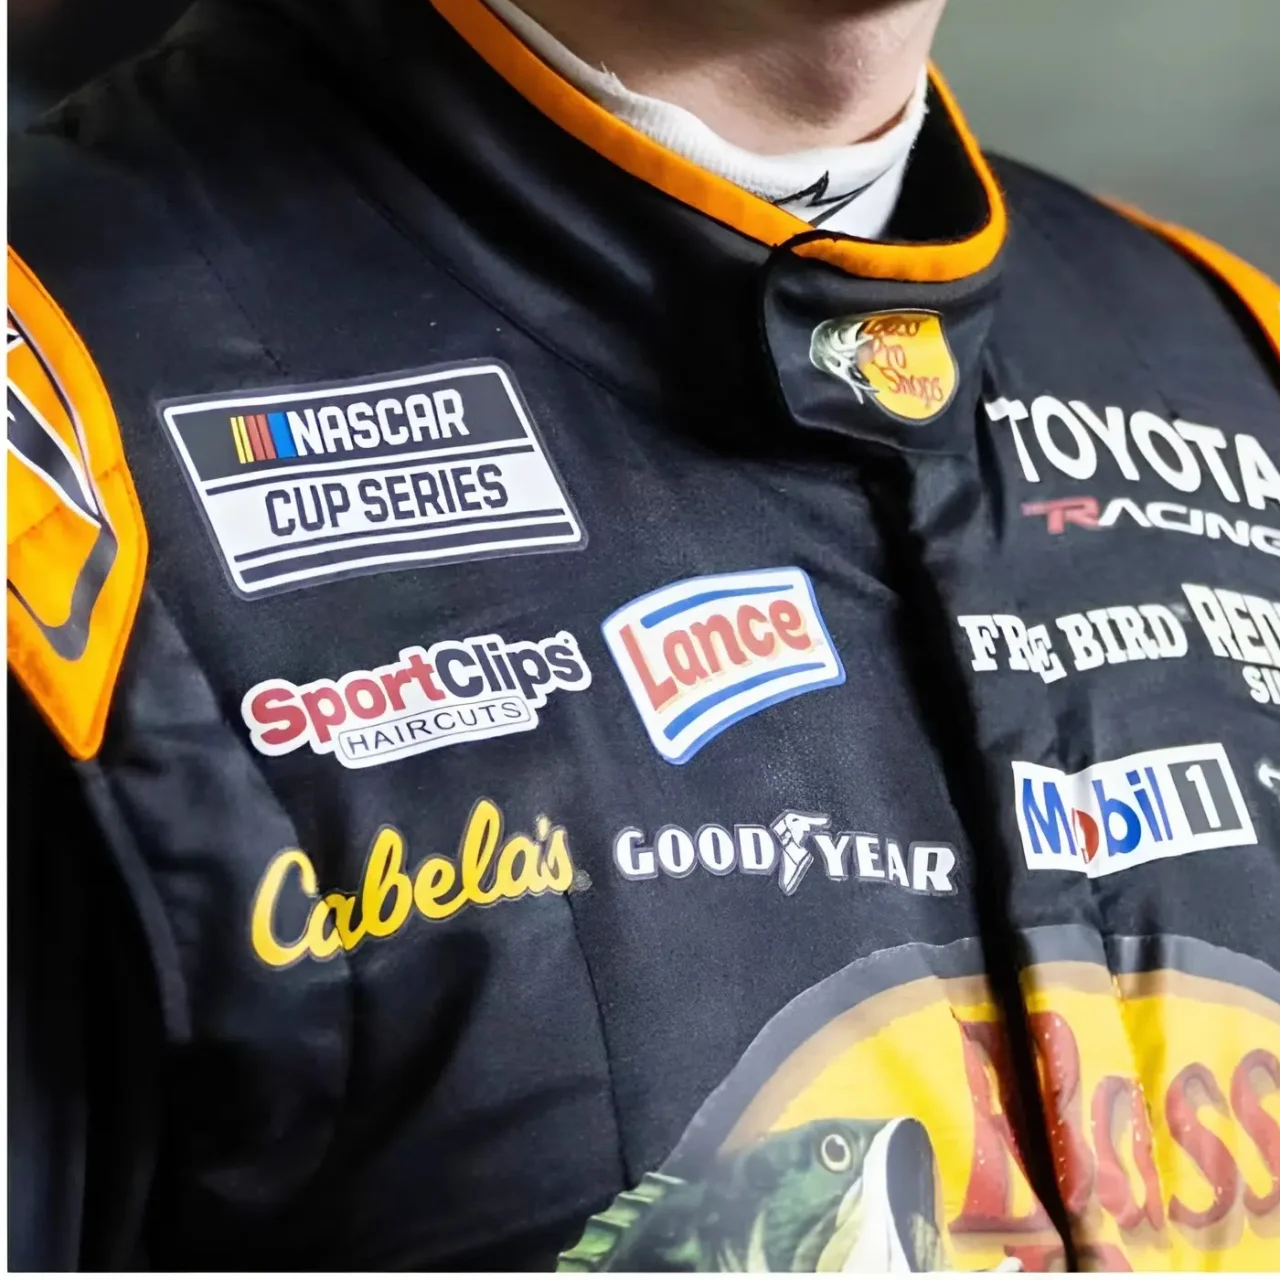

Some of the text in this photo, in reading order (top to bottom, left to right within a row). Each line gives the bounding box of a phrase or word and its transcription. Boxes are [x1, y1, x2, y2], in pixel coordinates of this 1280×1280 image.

[287, 388, 470, 456] NASCAR
[265, 464, 509, 536] CUP SERIES
[619, 599, 813, 714] Lance
[1056, 604, 1188, 671] BIRD
[347, 701, 522, 756] HAIRCUTS
[1022, 764, 1221, 864] Mobil 1
[251, 799, 574, 966] Cabela's
[613, 813, 959, 894] GOODYEAR
